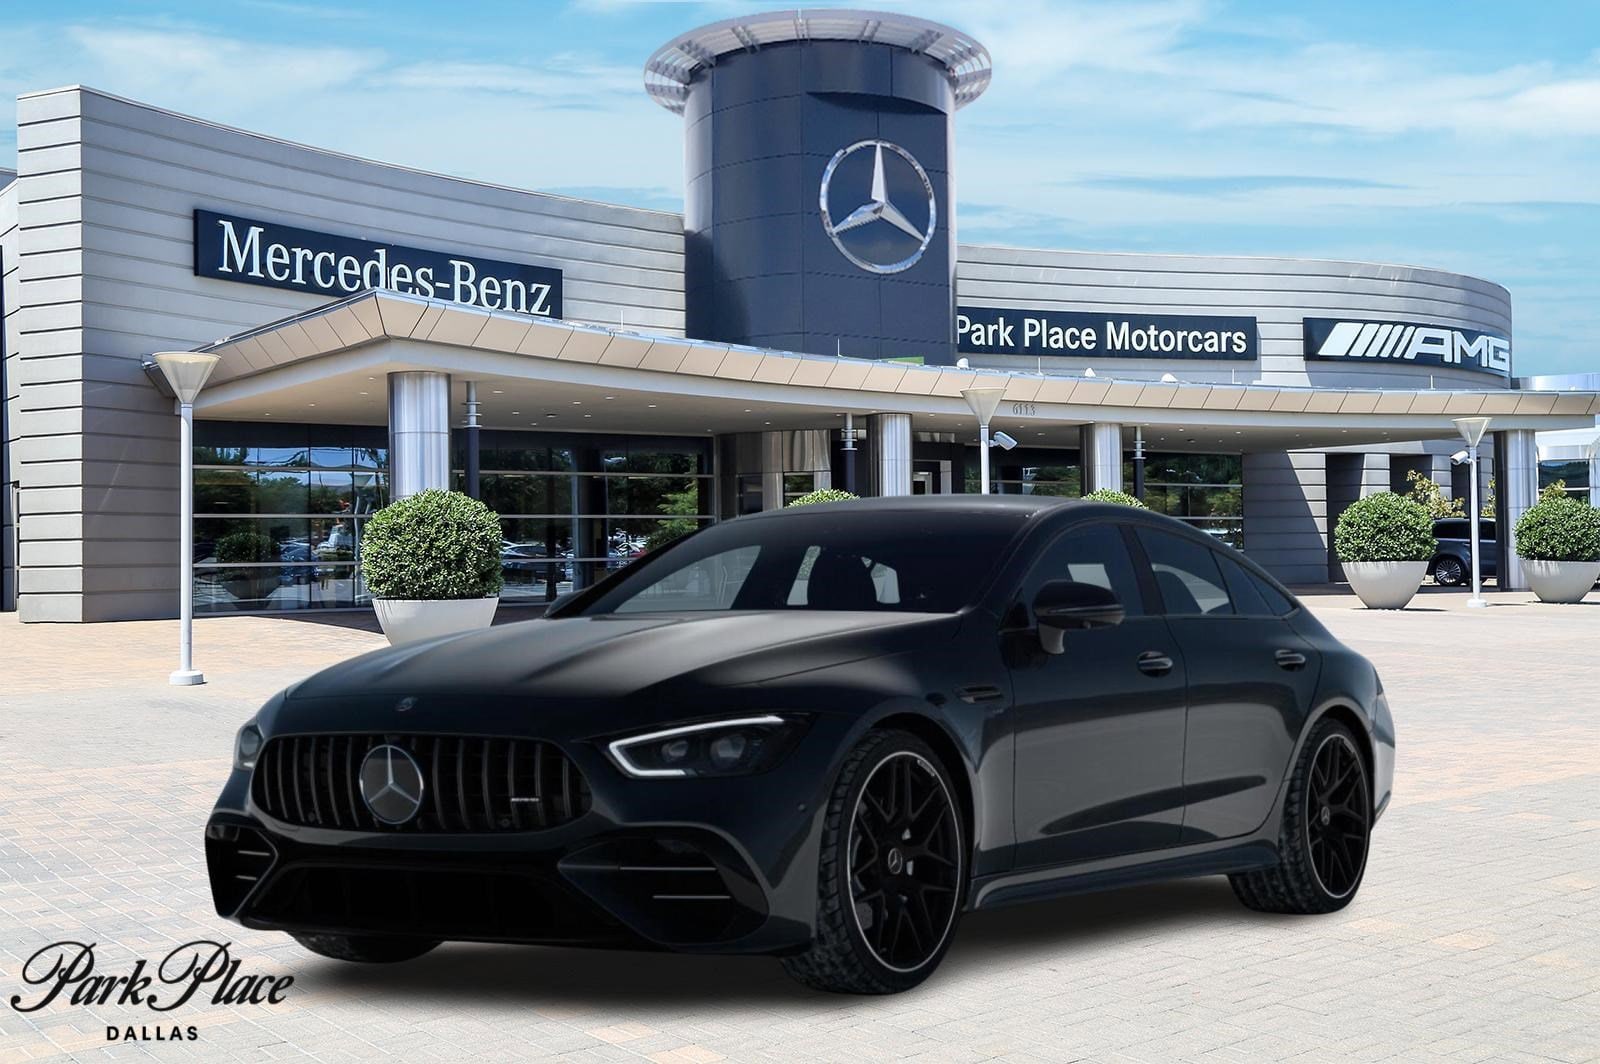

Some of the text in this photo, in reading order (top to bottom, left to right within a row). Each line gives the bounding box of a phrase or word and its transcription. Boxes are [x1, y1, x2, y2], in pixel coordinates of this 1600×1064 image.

[217, 220, 552, 316] Mercedes-Benz
[957, 314, 1247, 353] Park Place Motorcars
[1402, 326, 1510, 373] AMG
[1012, 402, 1036, 416] 6113
